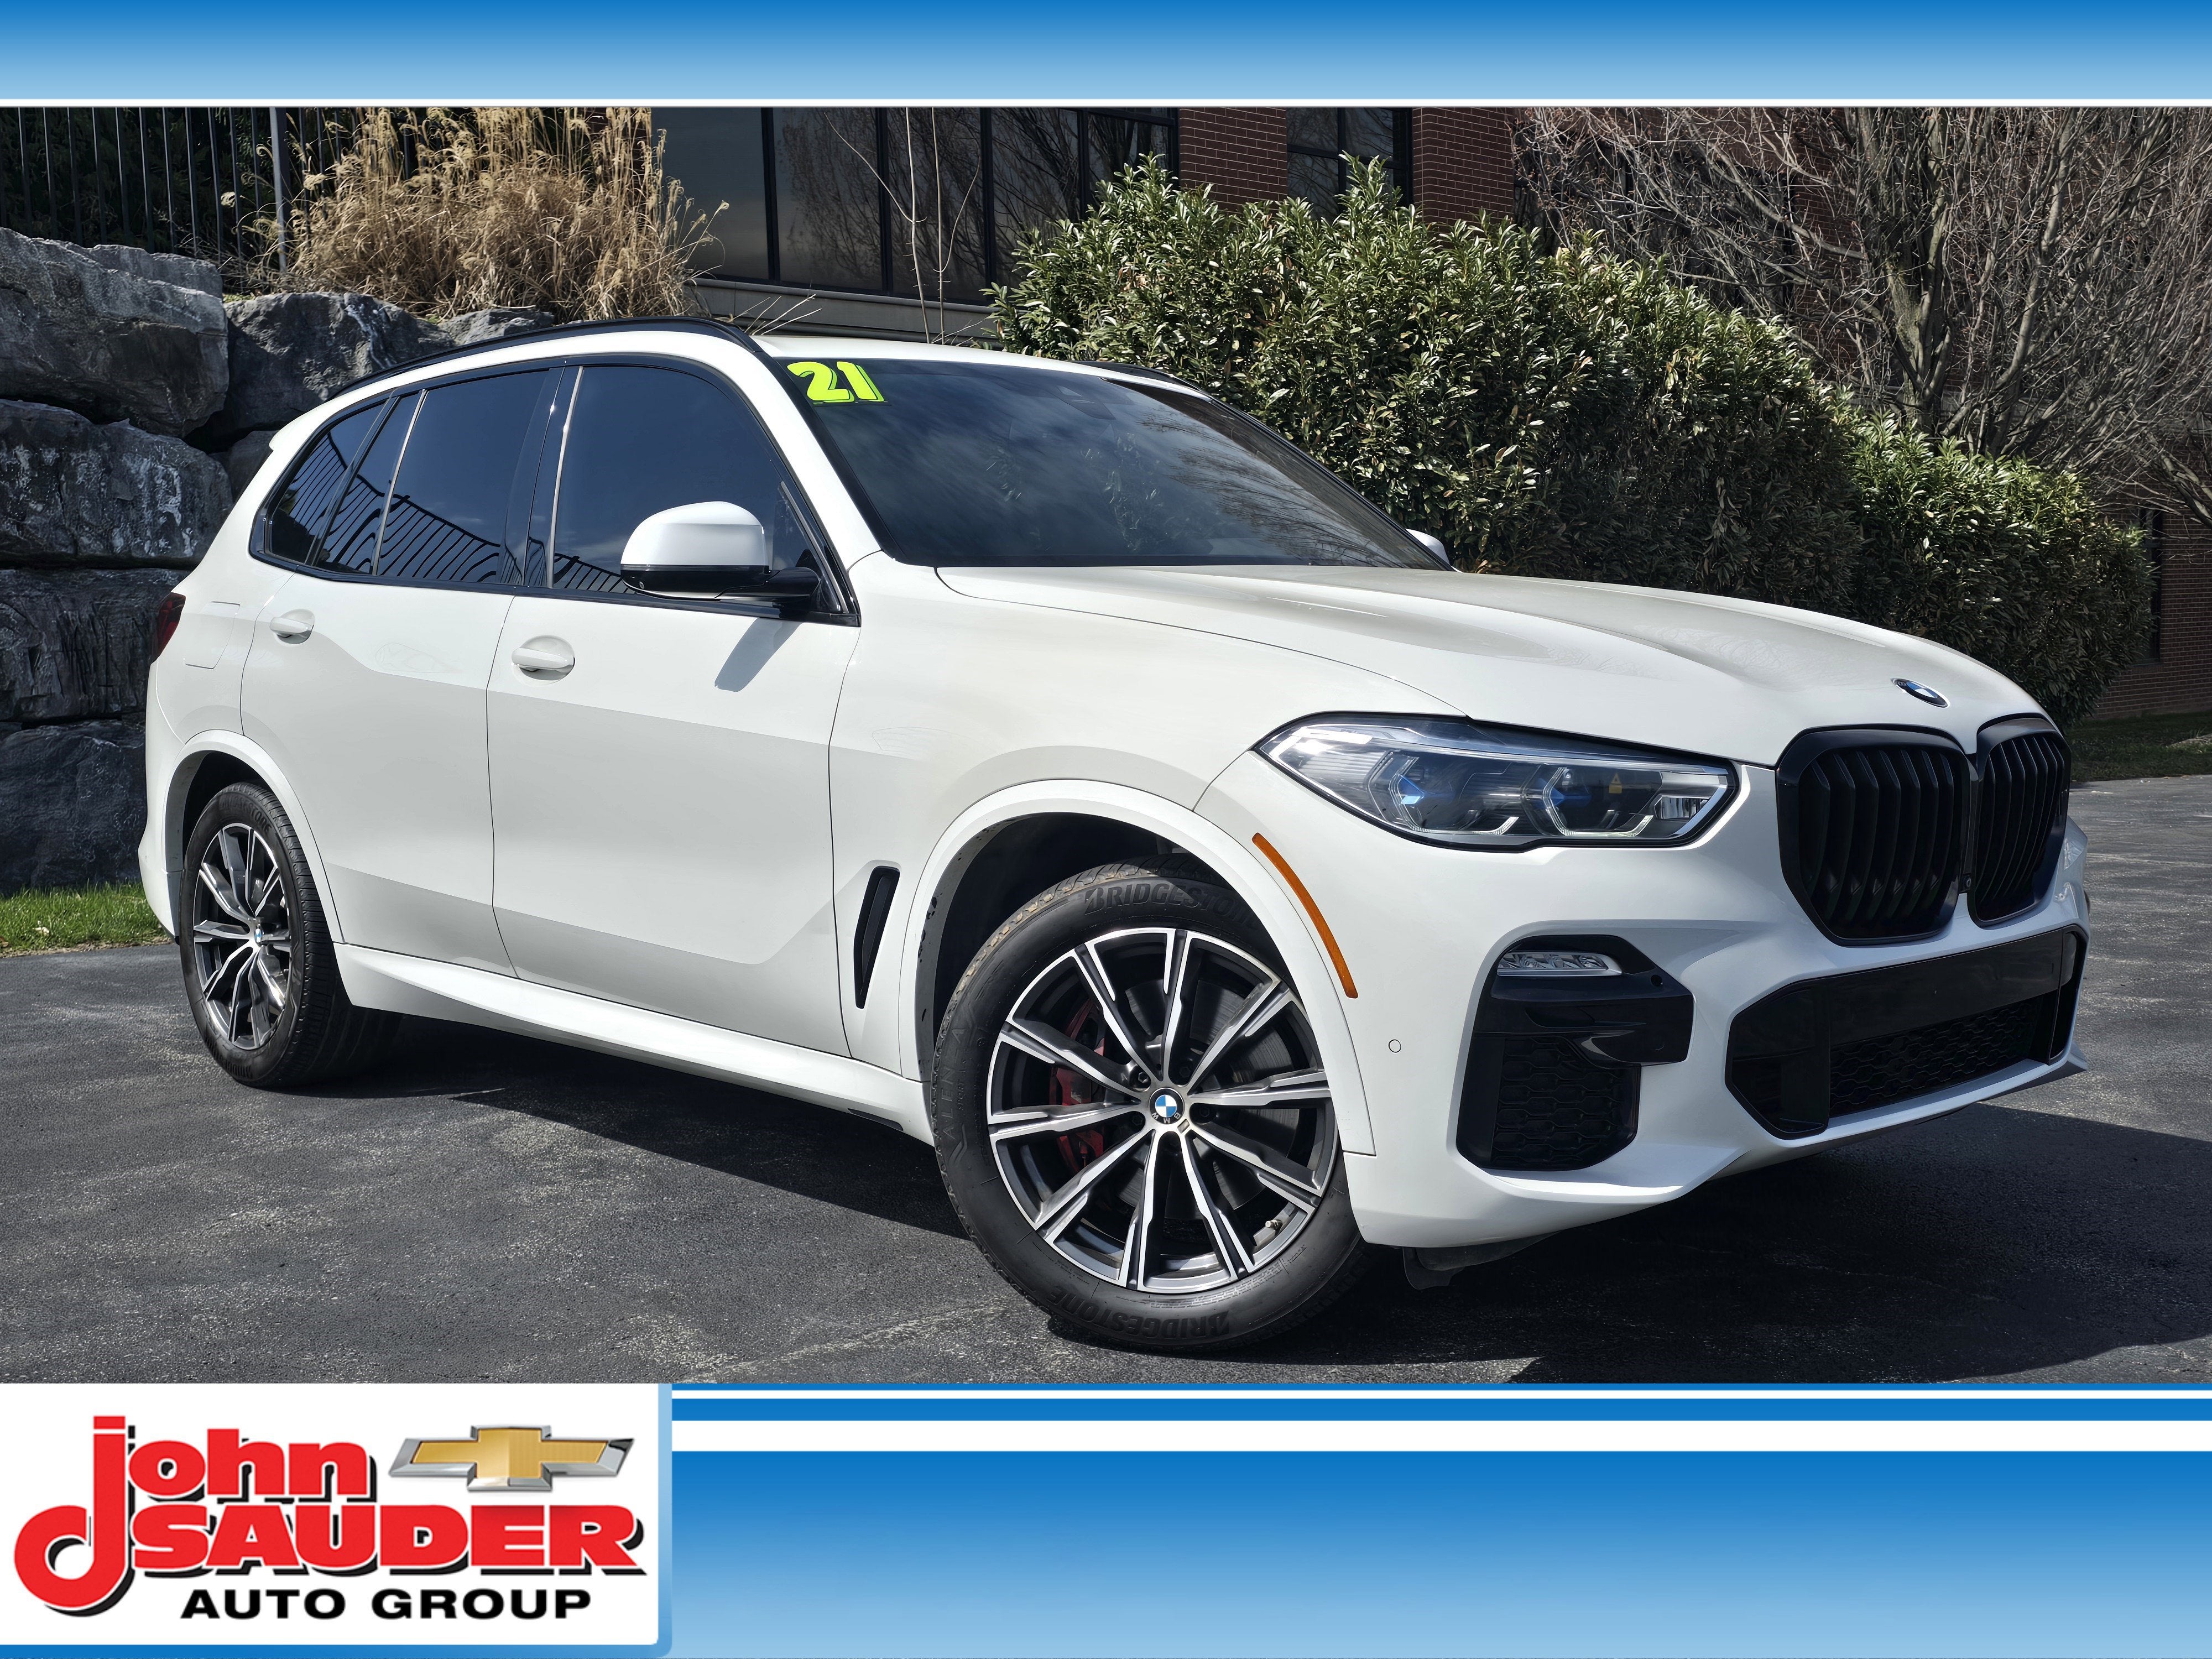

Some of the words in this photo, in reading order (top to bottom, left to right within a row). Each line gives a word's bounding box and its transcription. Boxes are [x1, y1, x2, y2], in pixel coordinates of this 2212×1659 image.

[787, 361, 884, 403] 21
[1151, 1112, 1181, 1124] BMW
[1045, 1286, 1230, 1339] BRIDGESTONE
